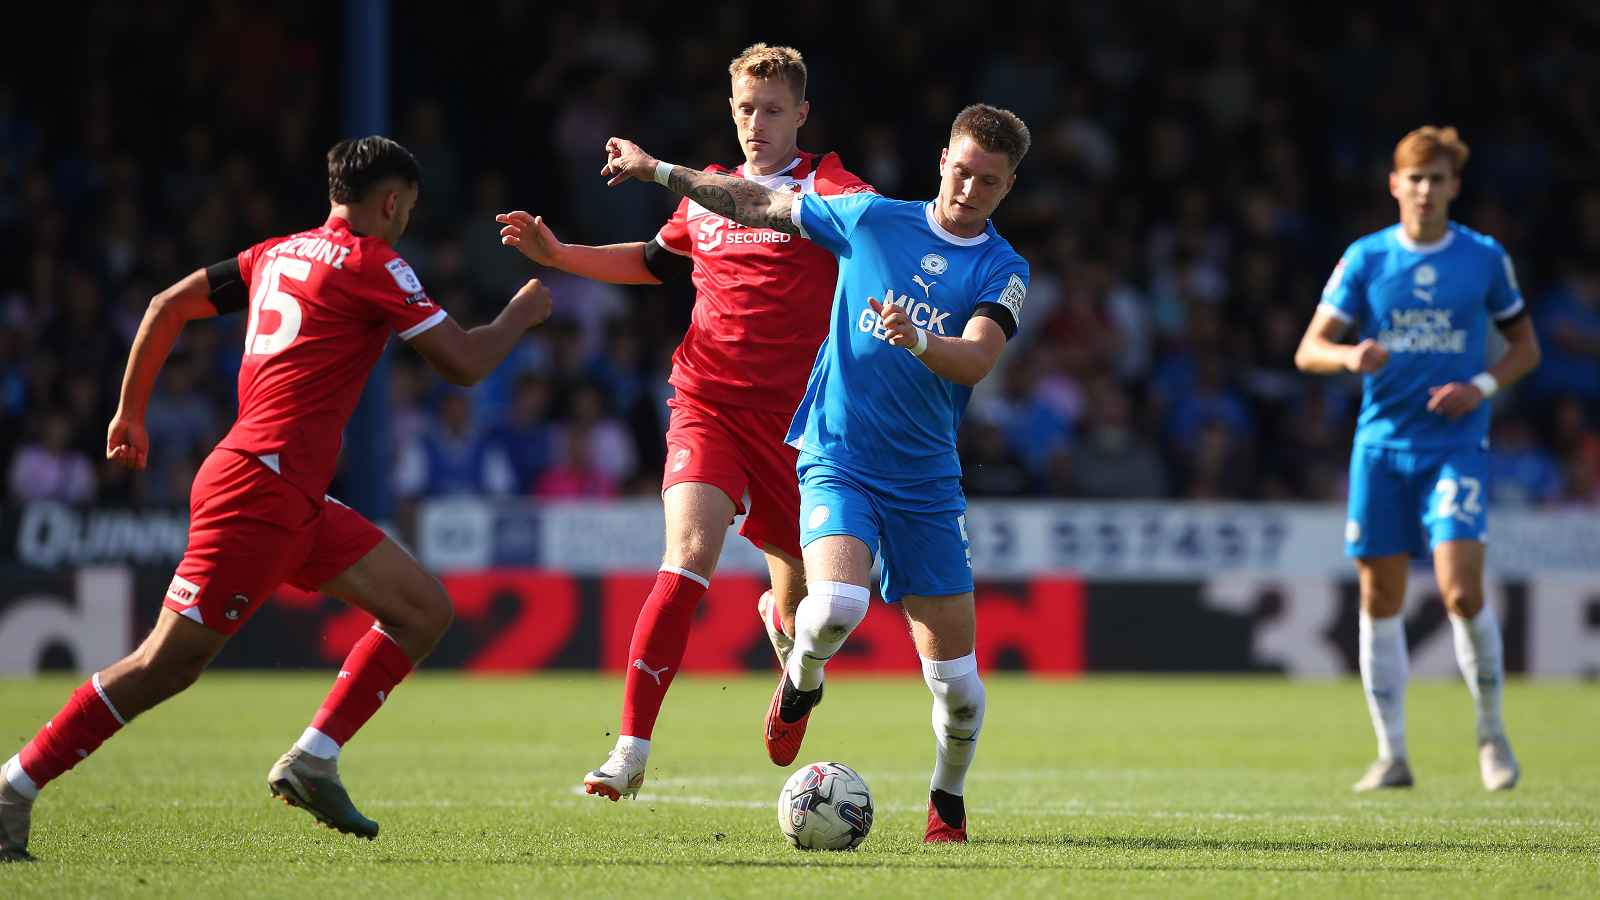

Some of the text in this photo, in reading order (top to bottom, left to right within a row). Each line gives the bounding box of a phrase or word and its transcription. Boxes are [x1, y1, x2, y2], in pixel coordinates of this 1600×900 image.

[725, 232, 791, 244] SECURED
[245, 256, 312, 355] 15
[883, 289, 951, 335] MICK
[1391, 308, 1453, 329] MICK
[1436, 477, 1483, 516] 22
